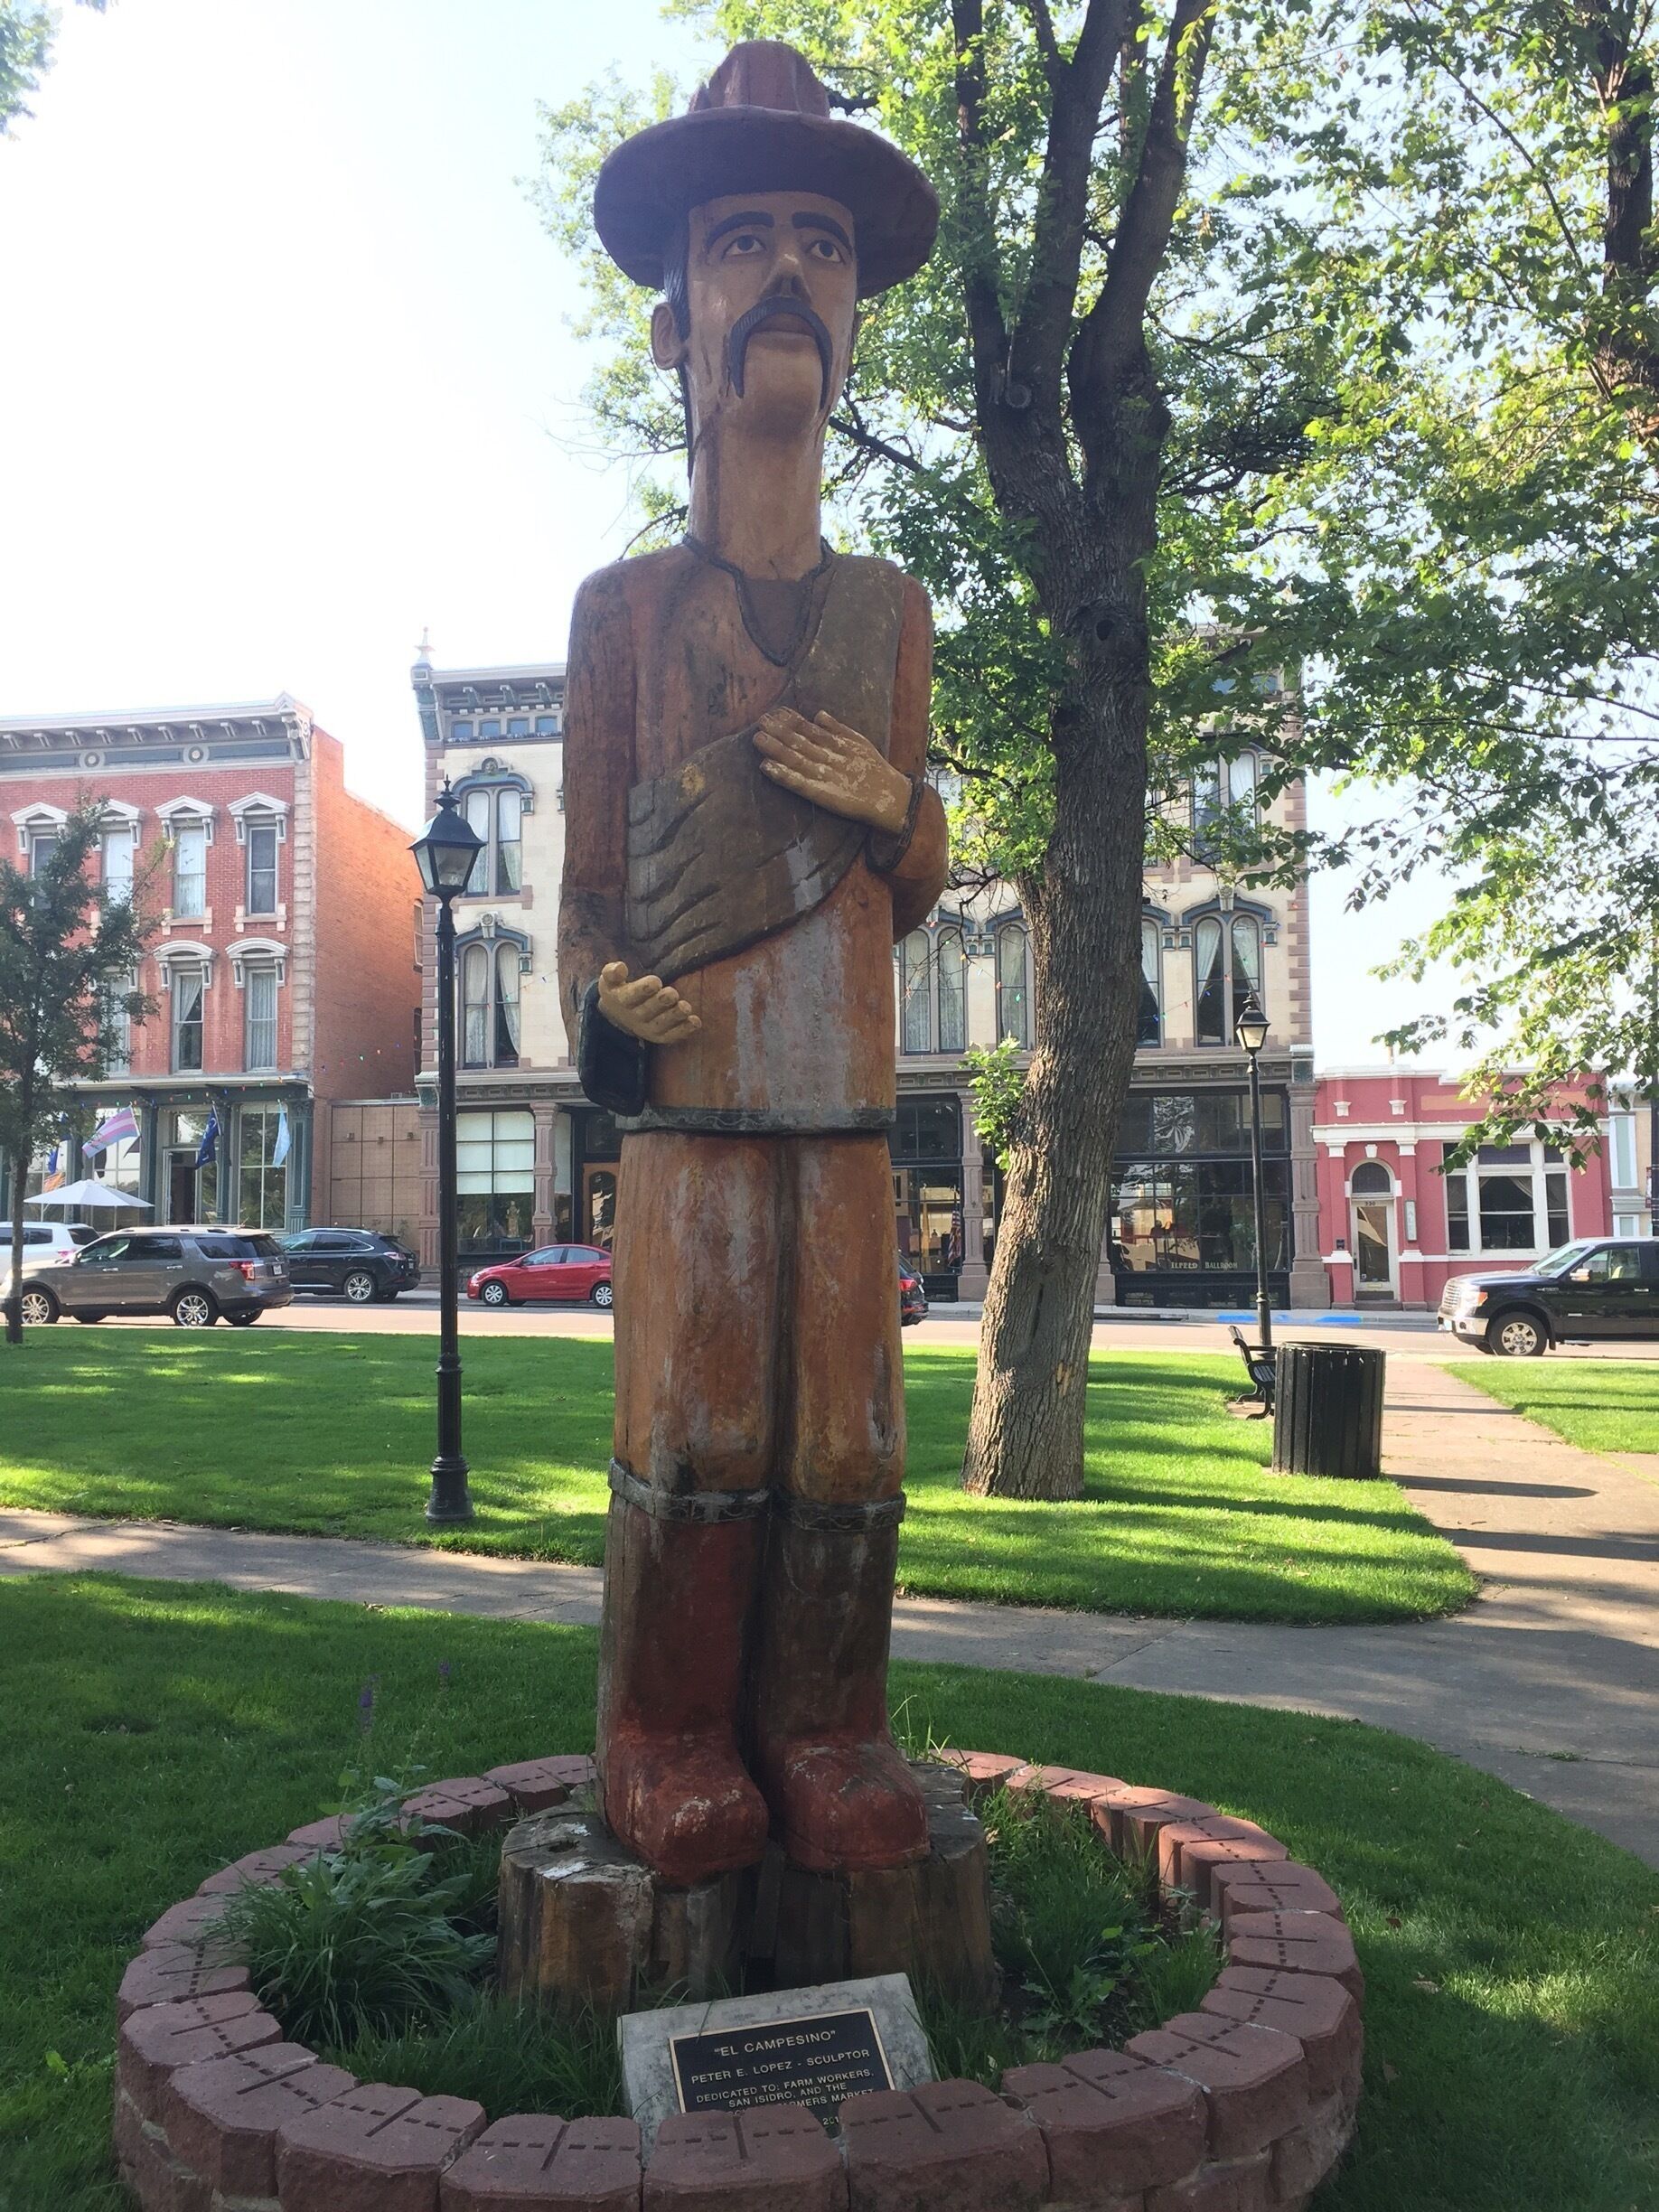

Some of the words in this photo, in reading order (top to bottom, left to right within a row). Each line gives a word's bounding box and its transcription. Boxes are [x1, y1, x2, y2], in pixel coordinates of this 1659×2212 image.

[1204, 1261, 1238, 1270] BALLROOM
[744, 2029, 836, 2053] CAMPESINO"
[691, 2070, 731, 2084] PETER
[736, 2068, 748, 2077] E.
[753, 2061, 792, 2075] LOPEZ
[807, 2049, 870, 2067] SCULPTOR
[696, 2088, 757, 2103] DEDICATED
[762, 2084, 780, 2092] TO:
[784, 2078, 813, 2089] FARM
[817, 2069, 875, 2085] WORKERS,
[729, 2097, 751, 2108] SAN
[755, 2091, 796, 2104] ISIDRO,
[800, 2086, 821, 2096] AND
[826, 2082, 847, 2092] THE
[823, 2115, 839, 2125] 201
